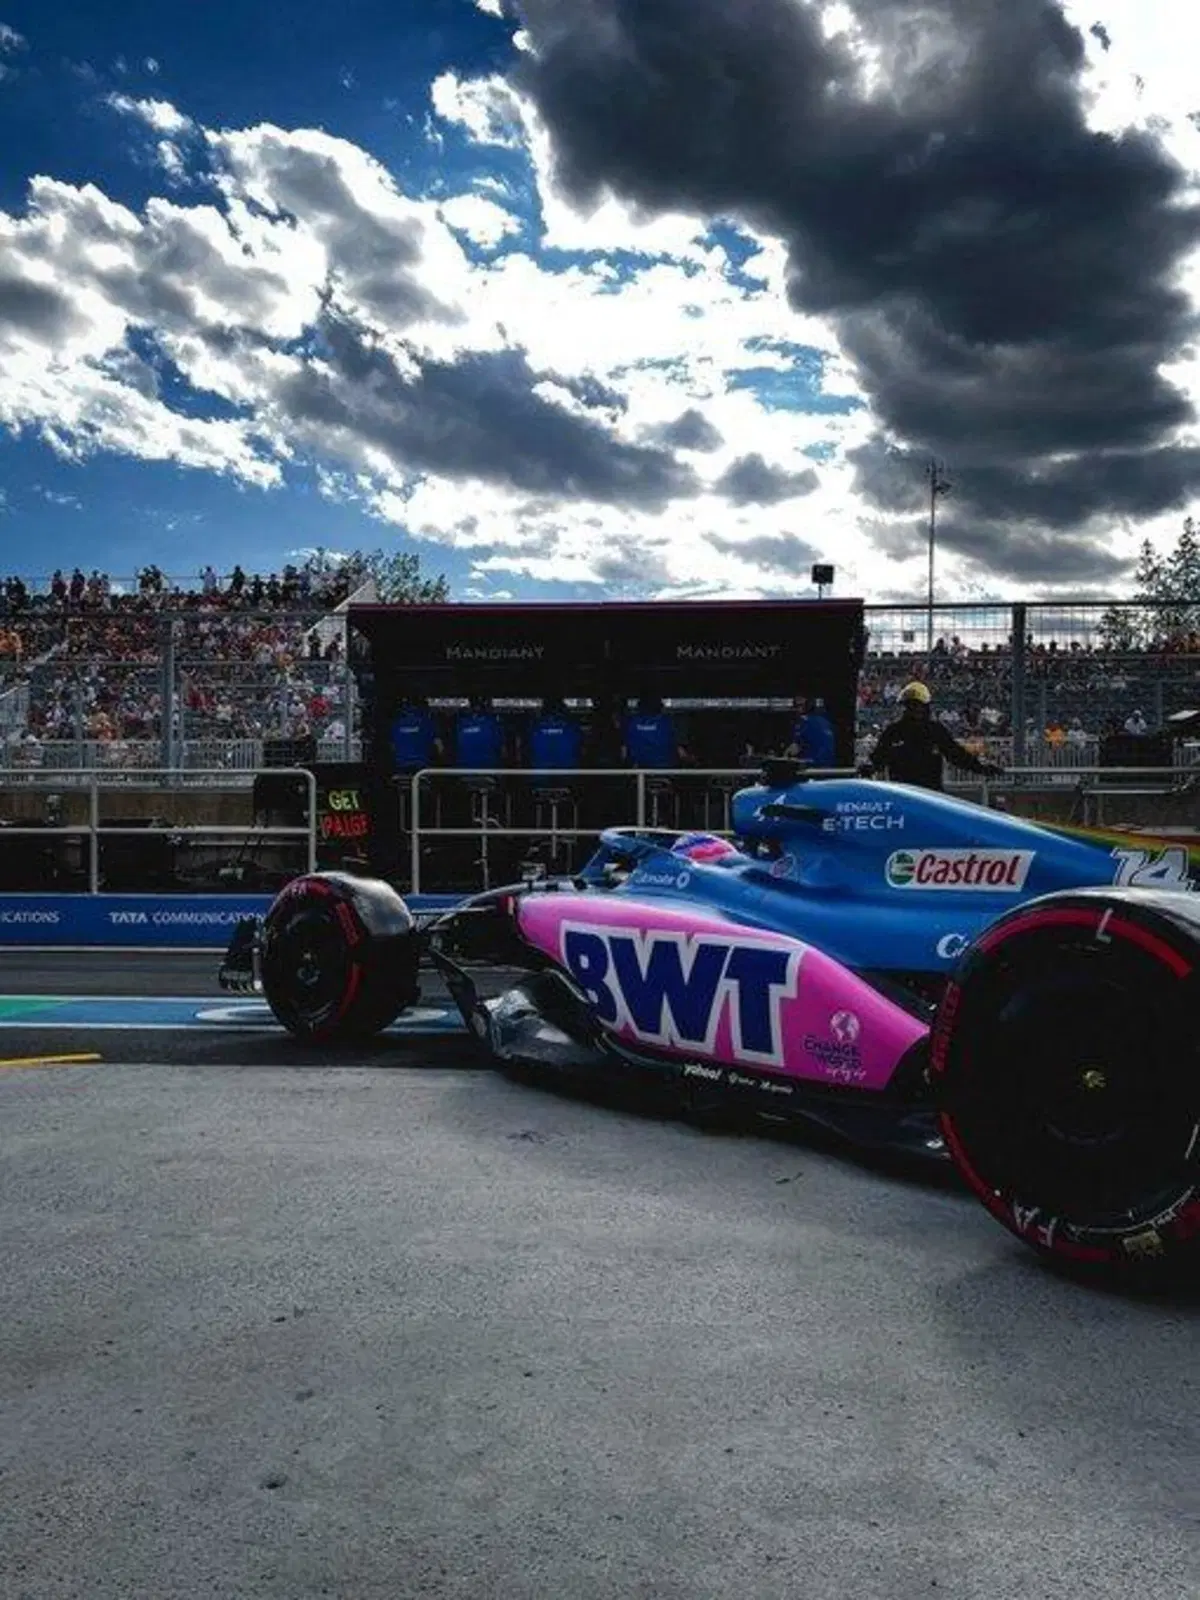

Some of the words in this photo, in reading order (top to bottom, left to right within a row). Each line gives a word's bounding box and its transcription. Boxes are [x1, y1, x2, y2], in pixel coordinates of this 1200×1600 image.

[446, 646, 545, 660] MANDIANT
[676, 645, 781, 660] MANDIANT
[328, 789, 361, 811] GET
[836, 801, 894, 813] RENAULT
[915, 853, 1021, 886] Castrol
[109, 911, 149, 923] TATA
[564, 930, 794, 1056] BWT
